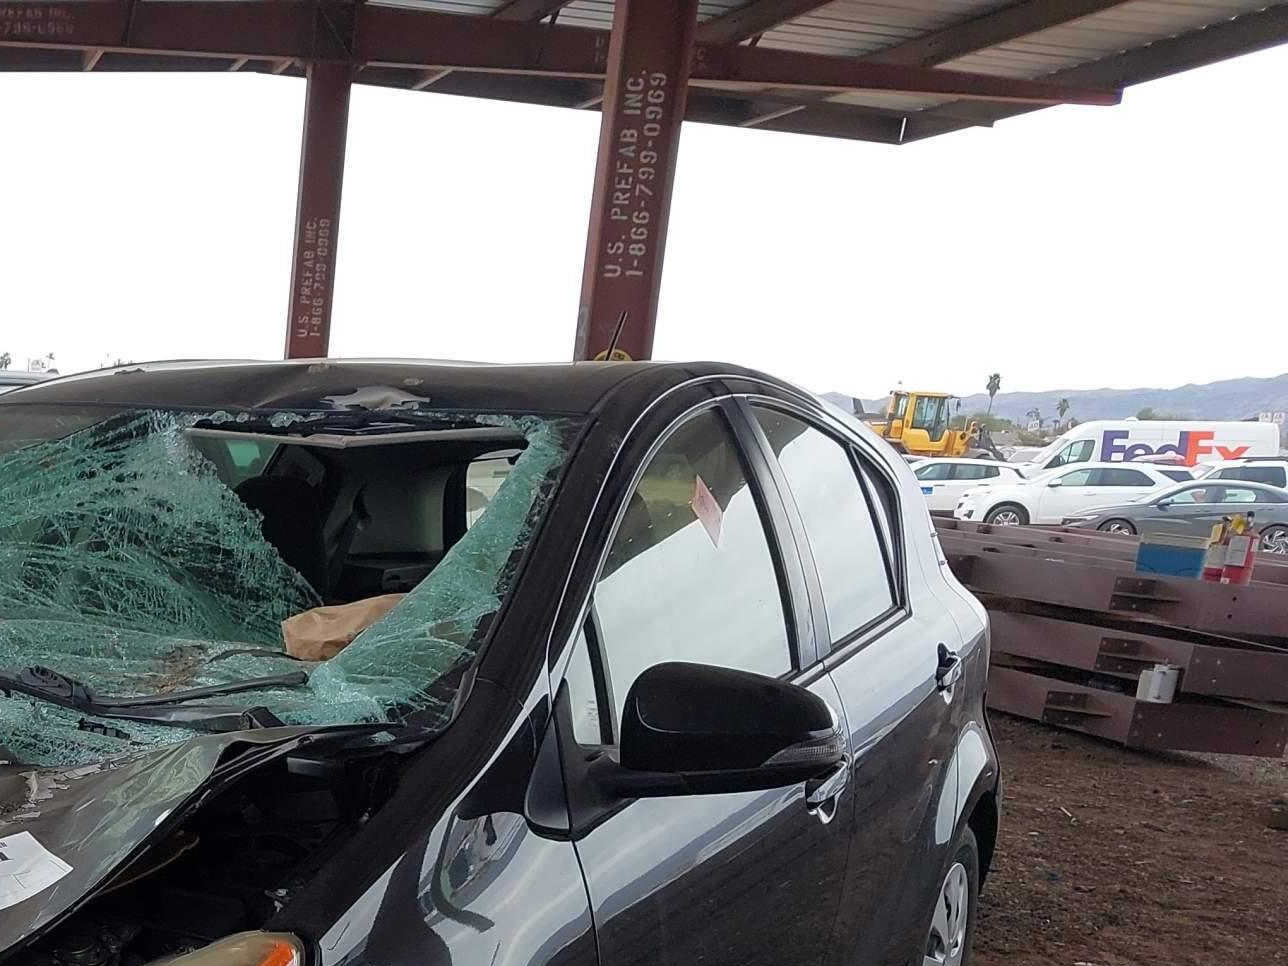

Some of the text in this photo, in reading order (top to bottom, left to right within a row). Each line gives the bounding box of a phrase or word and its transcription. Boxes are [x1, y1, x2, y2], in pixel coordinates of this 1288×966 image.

[603, 69, 647, 278] U.S. PREFAB INC.
[625, 72, 668, 277] 1-866-799-0969
[299, 250, 315, 304] PREFAB
[1099, 429, 1251, 467] FedEx
